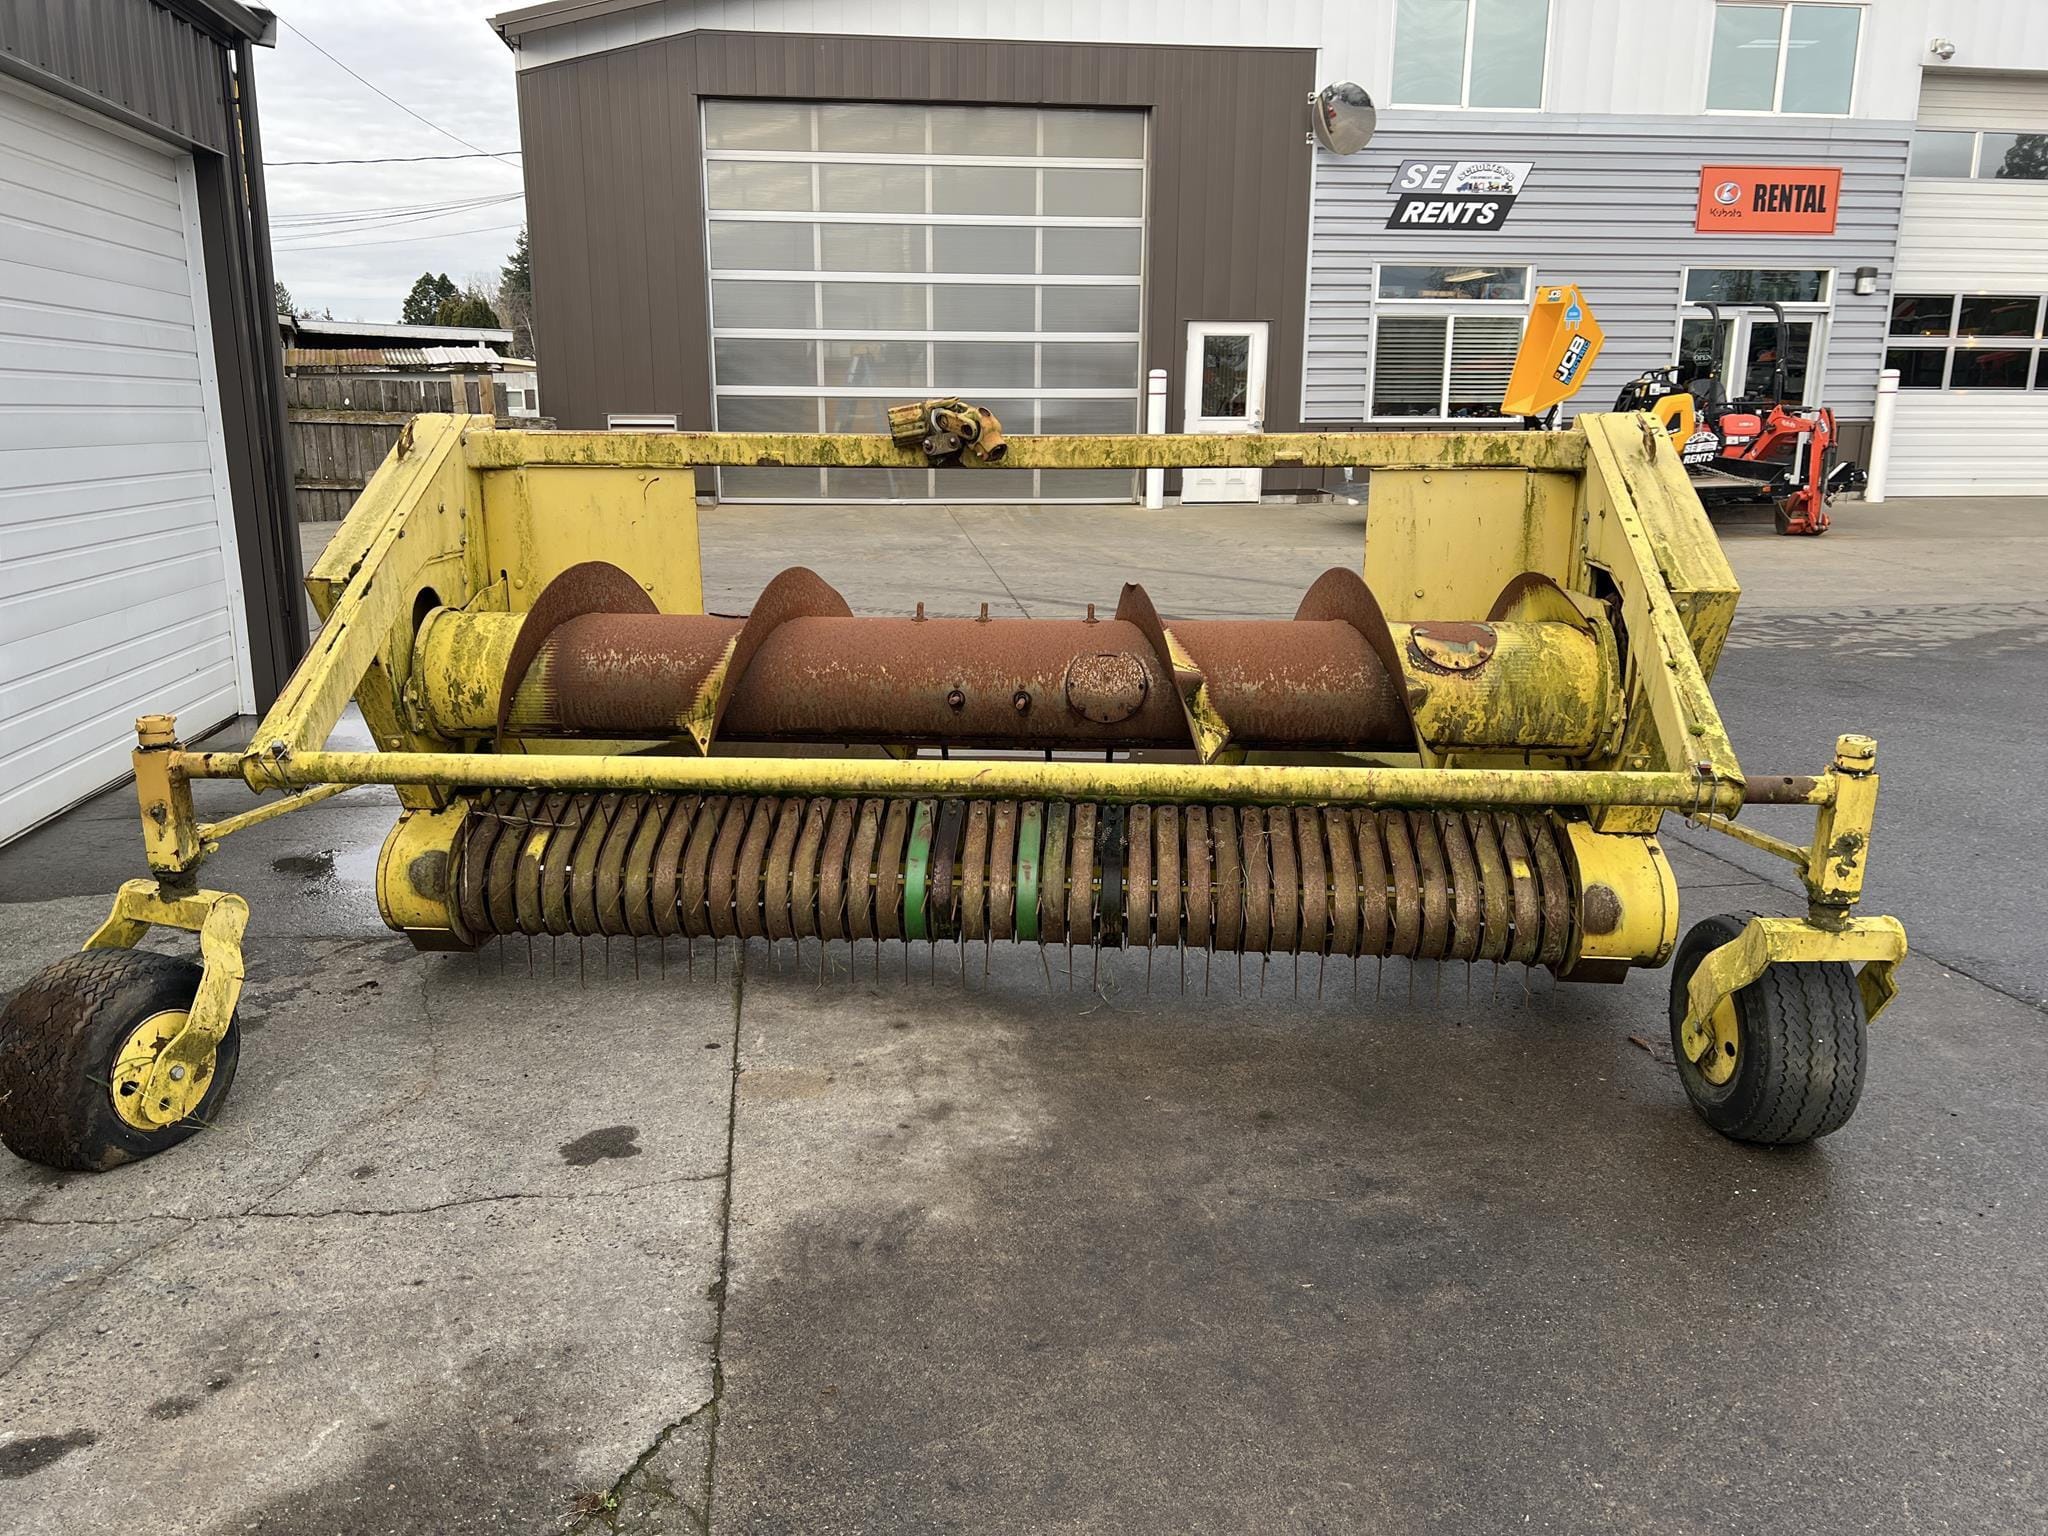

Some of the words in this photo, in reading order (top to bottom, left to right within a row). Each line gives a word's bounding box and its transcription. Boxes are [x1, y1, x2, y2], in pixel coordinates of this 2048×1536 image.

[1400, 163, 1452, 189] SE
[1457, 163, 1516, 182] SCHOLTEN'S
[1752, 183, 1827, 213] RENTAL
[1399, 201, 1500, 225] RENTS
[1710, 208, 1742, 217] Kubota
[1558, 335, 1586, 382] JCB
[1693, 353, 1712, 361] OPEN
[1683, 452, 1715, 465] RENTS
